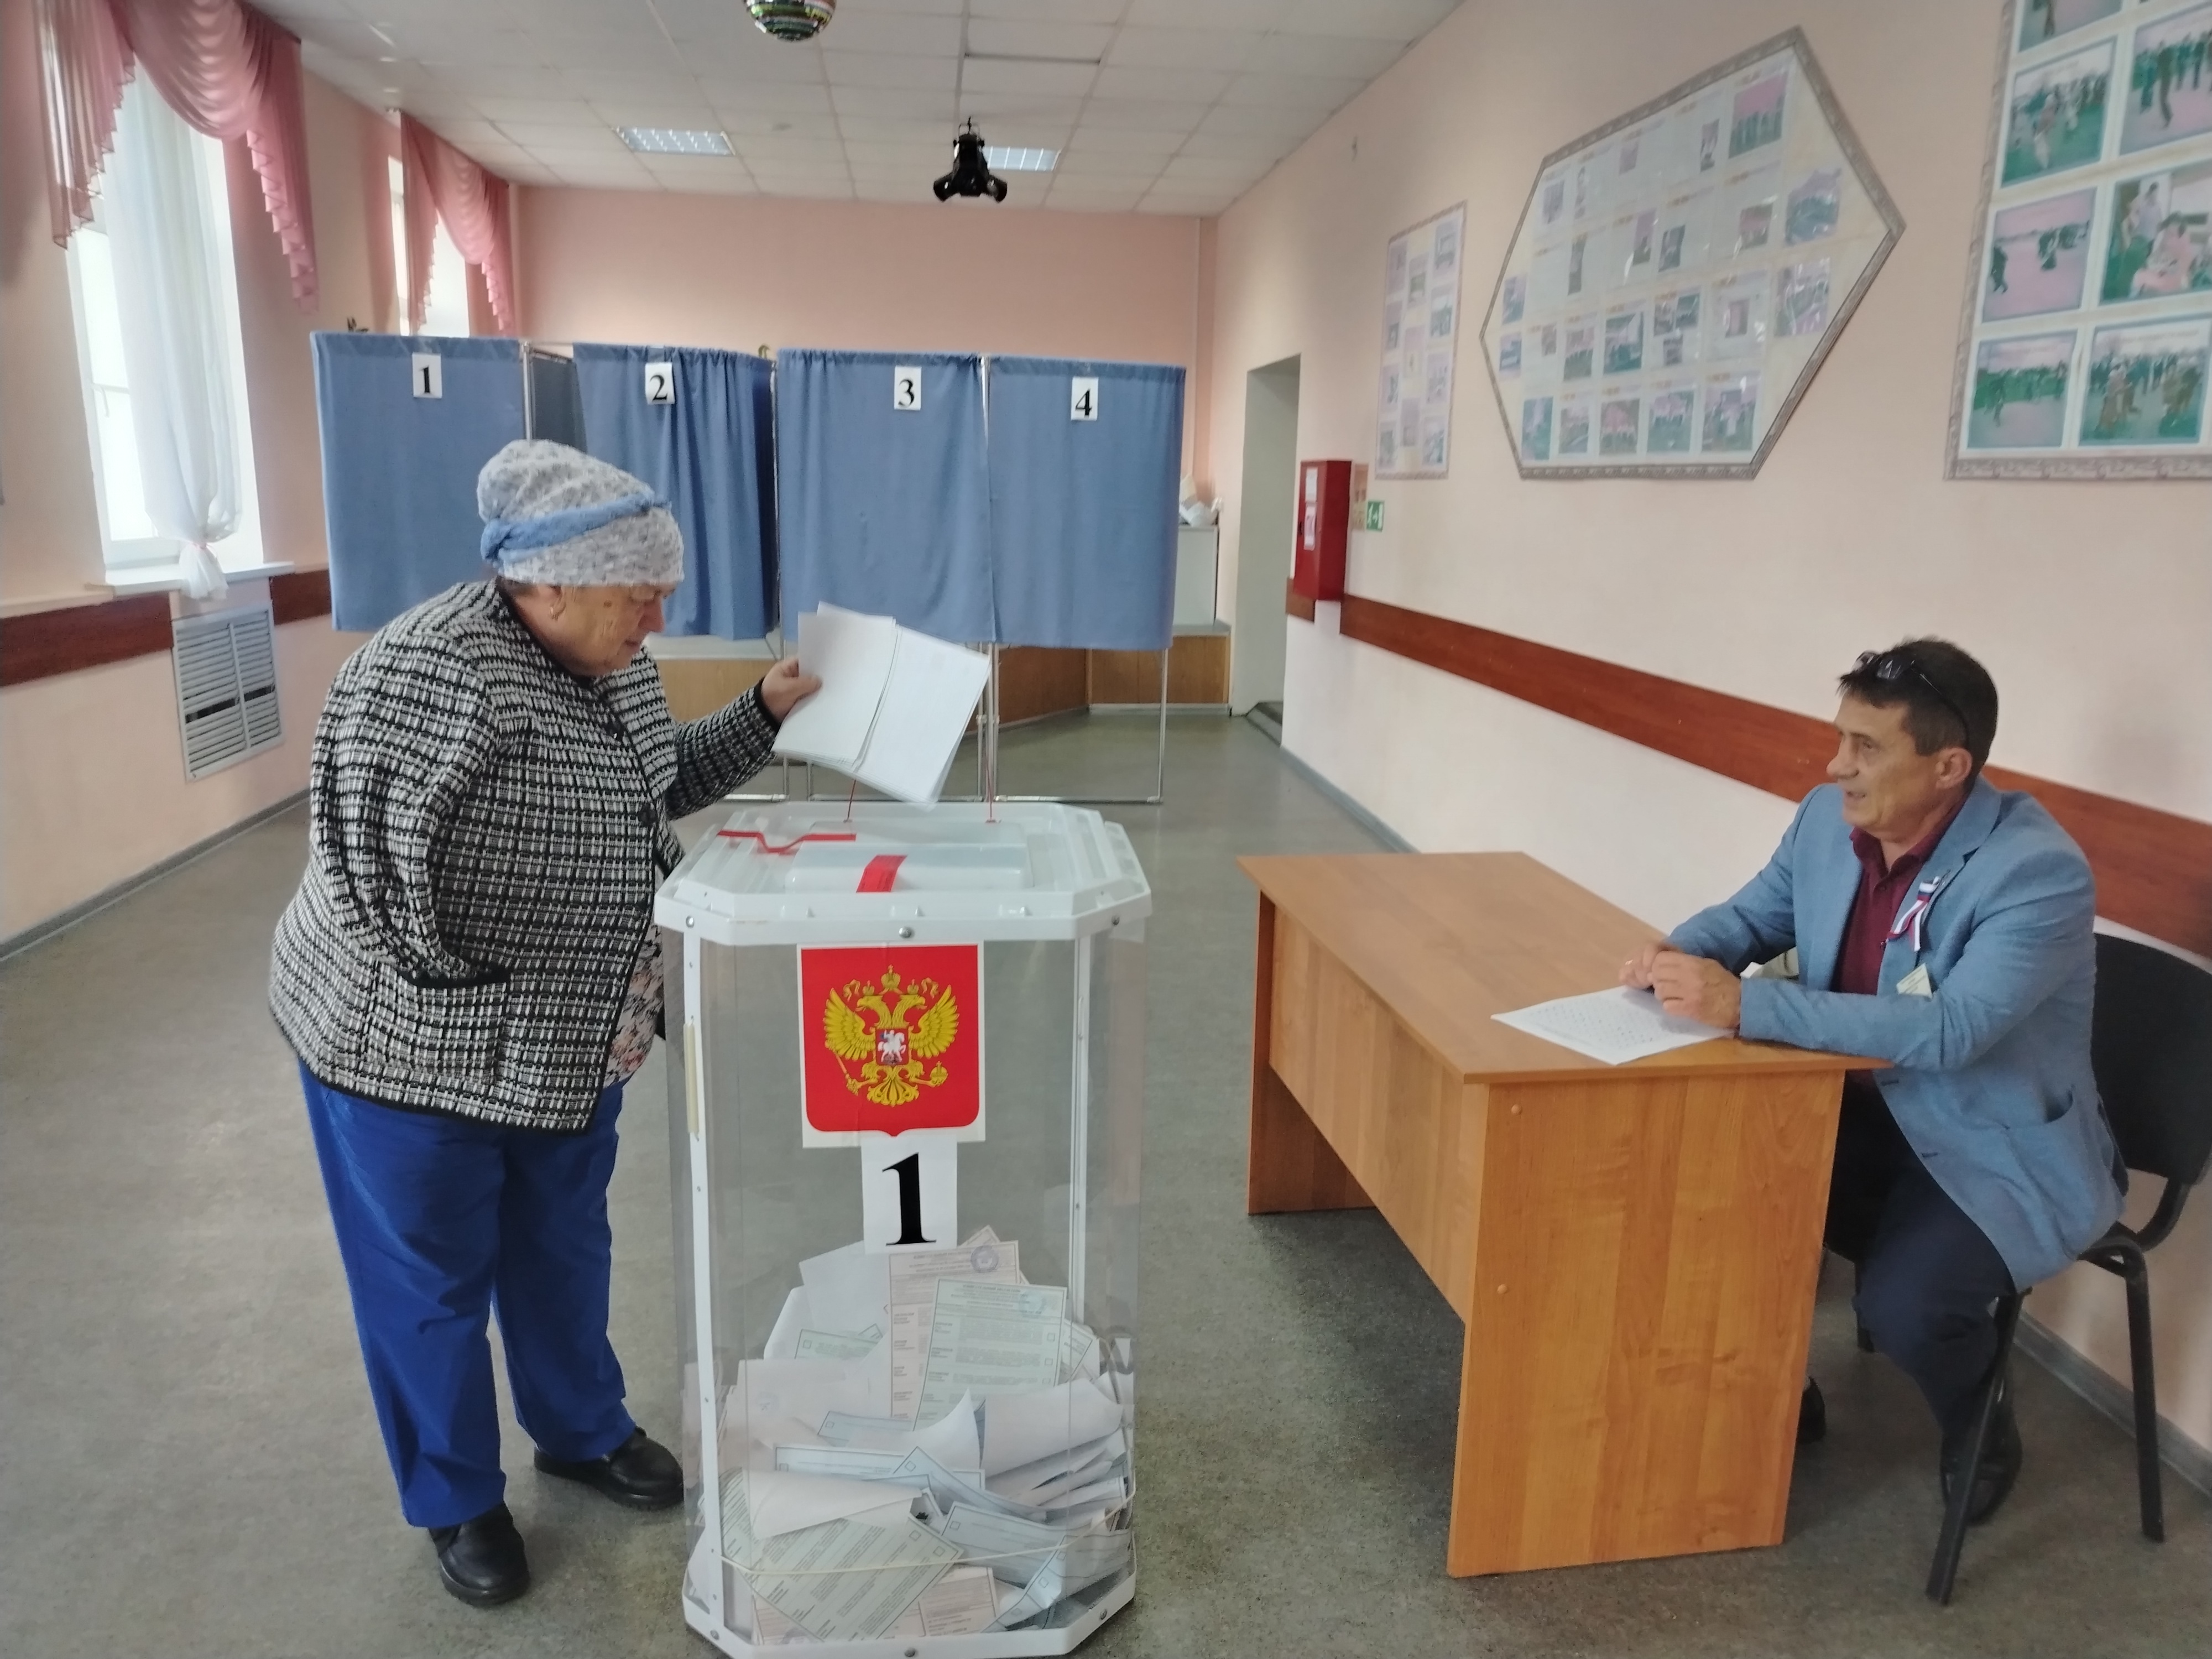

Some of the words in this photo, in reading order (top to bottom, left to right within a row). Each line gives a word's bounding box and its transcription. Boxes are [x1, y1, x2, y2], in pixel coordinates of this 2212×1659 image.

[419, 366, 431, 394] 1
[649, 374, 667, 401] 2
[898, 379, 915, 408] 3
[1075, 388, 1092, 416] 4
[882, 1152, 937, 1245] 1
